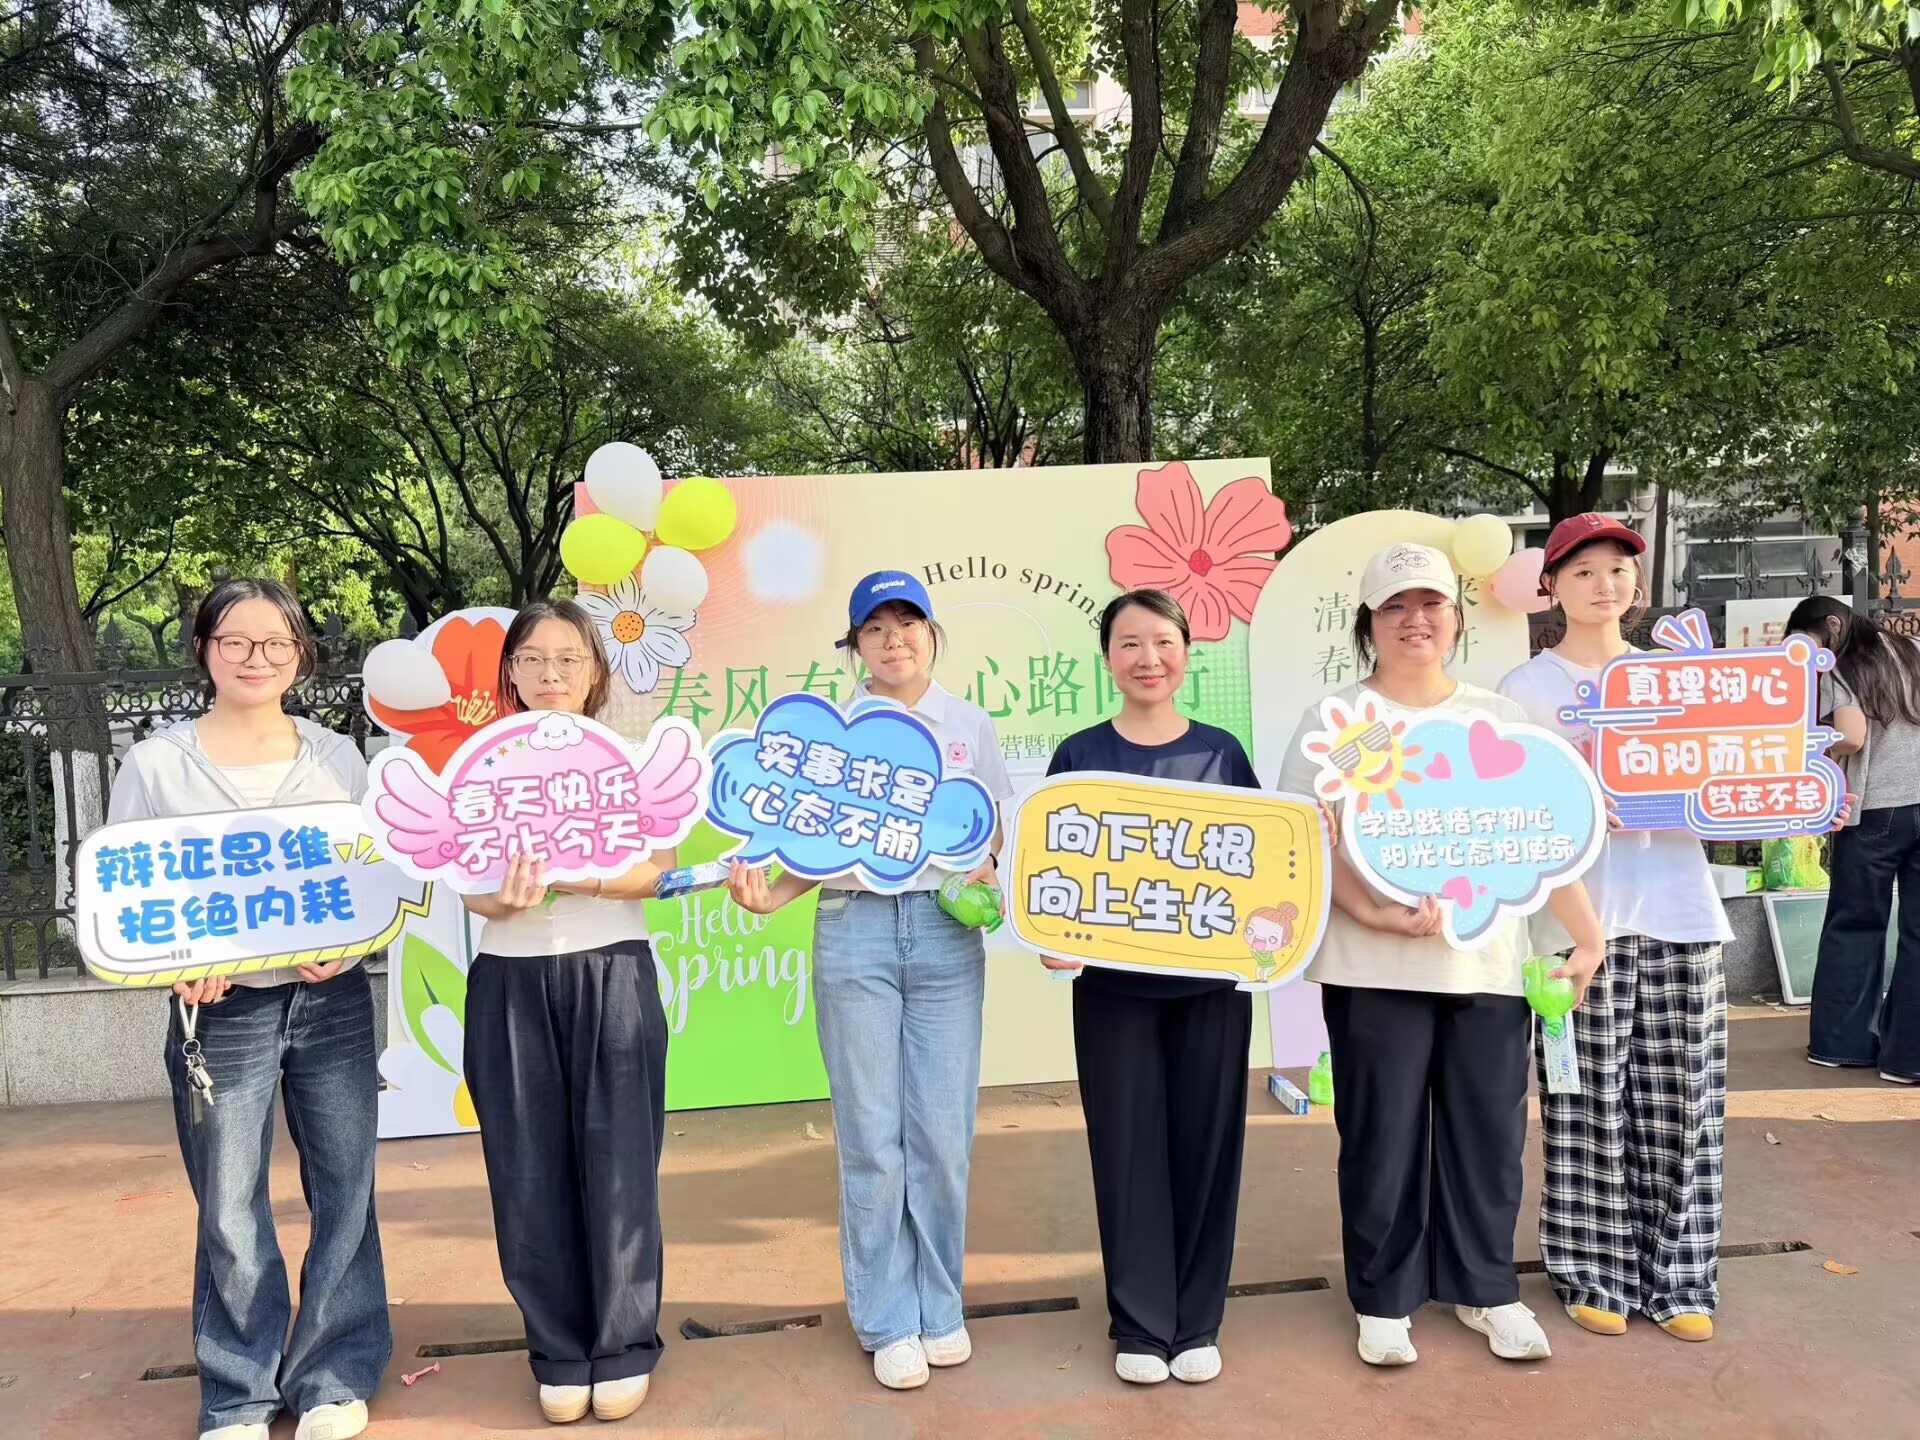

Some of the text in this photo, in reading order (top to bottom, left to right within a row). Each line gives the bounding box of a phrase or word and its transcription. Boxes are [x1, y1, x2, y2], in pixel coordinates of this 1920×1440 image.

[922, 556, 1107, 631] Hello spring
[652, 660, 872, 733] 春风有
[1625, 664, 1789, 706] 真理润心
[755, 731, 938, 816] 实事求是
[1617, 734, 1789, 776] 向阳而行
[449, 762, 640, 826] 春天快乐
[740, 781, 923, 865] 心态不崩
[1358, 805, 1554, 838] 学思践悟守初心
[1707, 780, 1823, 815] 笃志不怠
[95, 825, 333, 892] 辩证思维
[454, 810, 645, 875] 不止今天
[1046, 803, 1256, 879] 向下扎根
[1380, 834, 1577, 869] 阳光心态担使命
[117, 875, 355, 945] 拒绝内耗
[676, 893, 772, 948] Hello
[1027, 866, 1237, 939] 向上生长
[648, 930, 812, 1034] Spring
